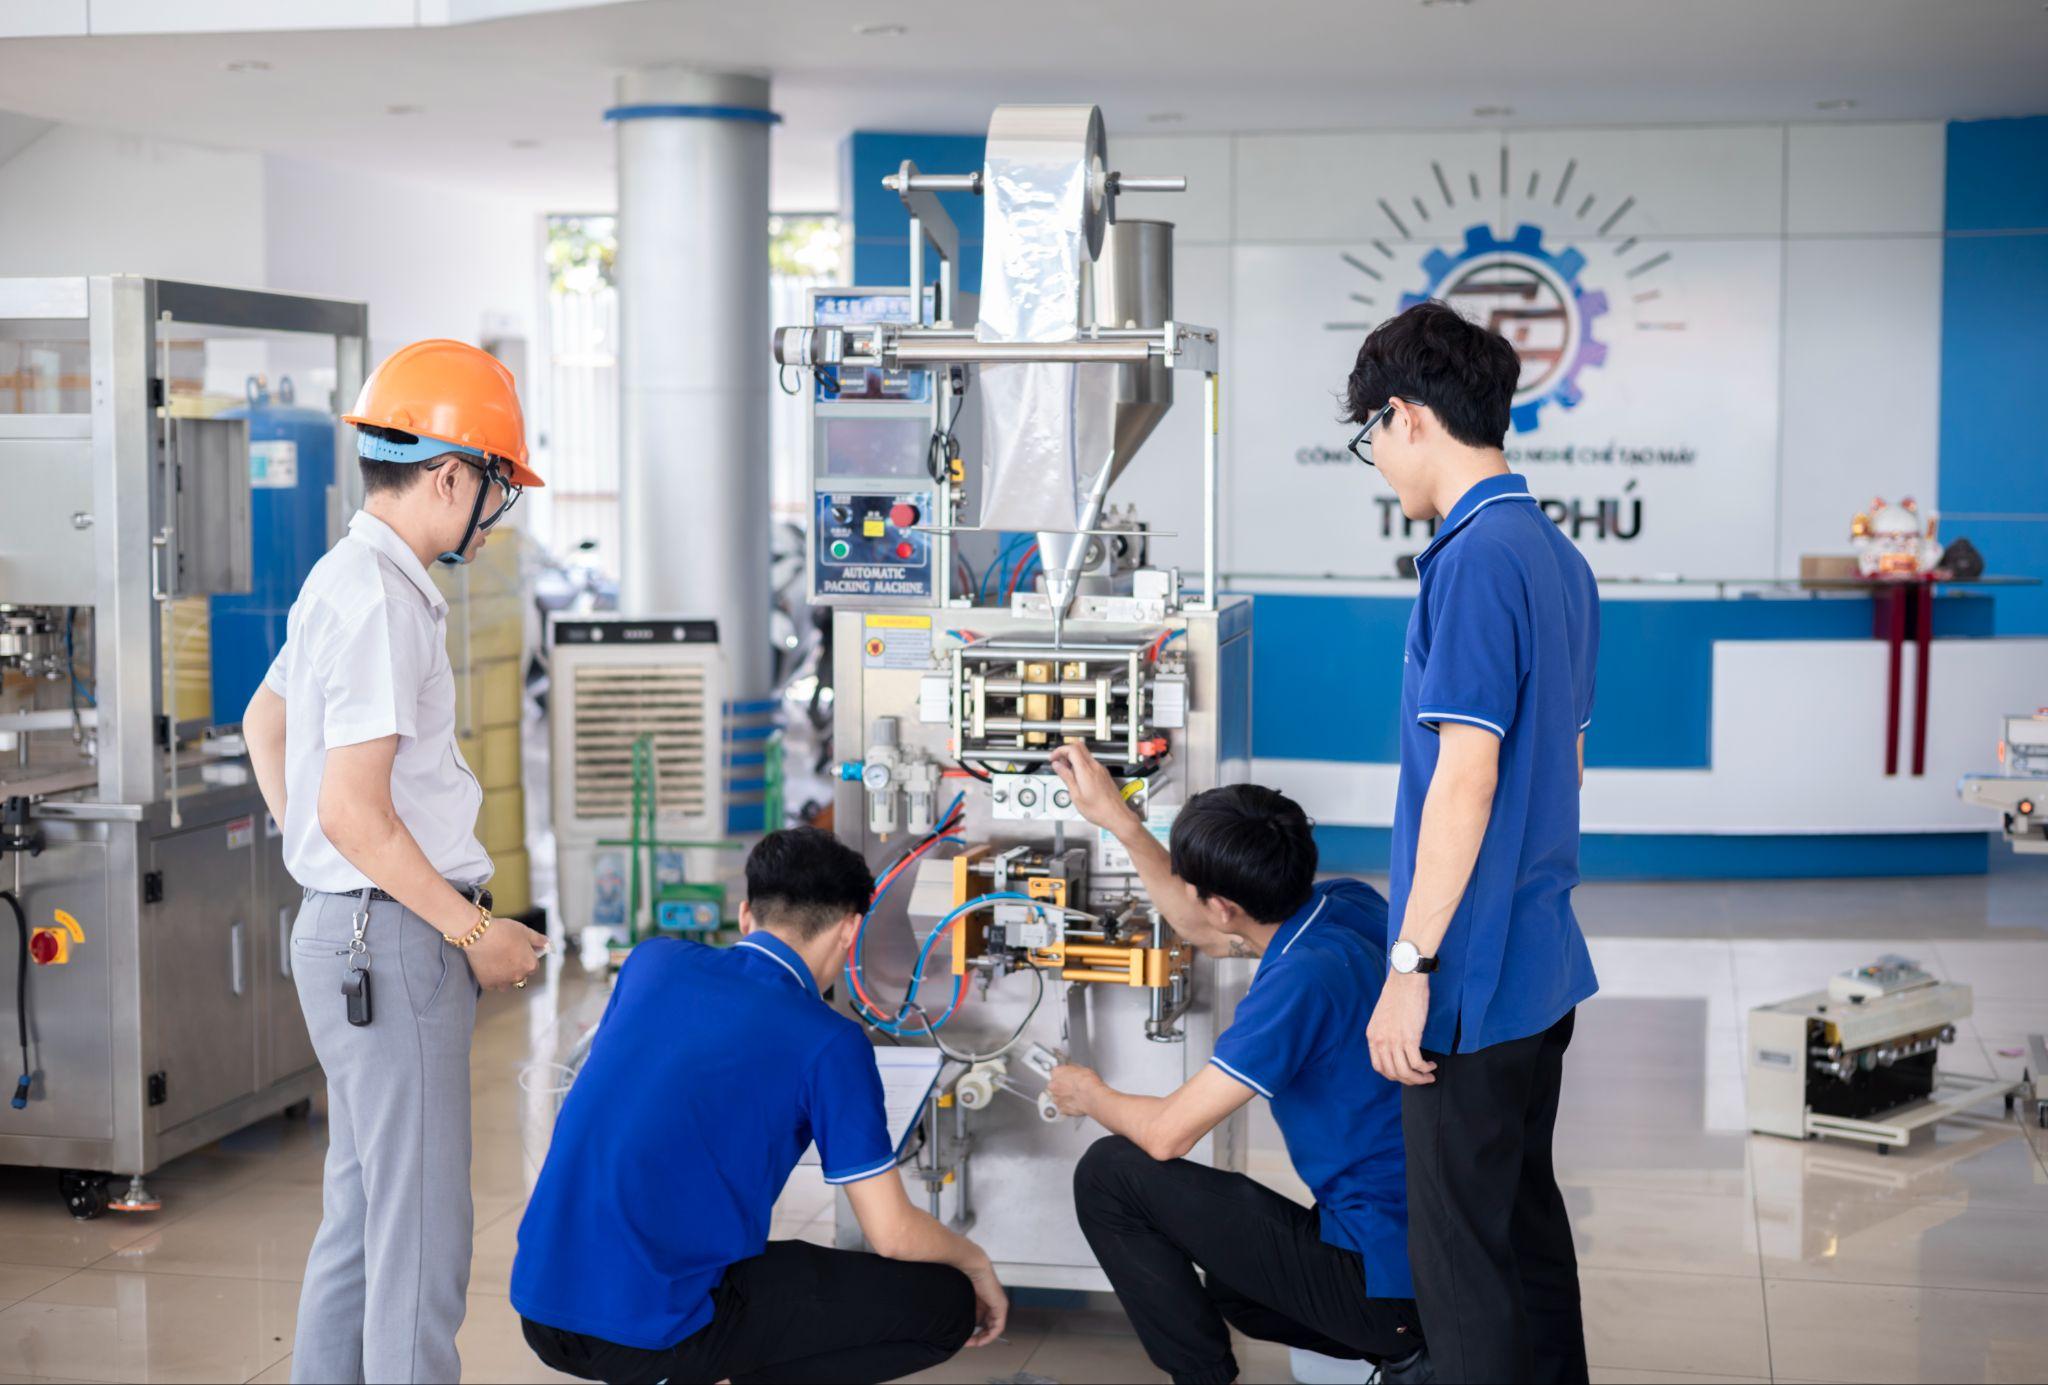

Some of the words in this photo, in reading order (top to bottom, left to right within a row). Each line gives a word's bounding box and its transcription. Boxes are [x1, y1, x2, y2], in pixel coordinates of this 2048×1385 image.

[1540, 478, 1642, 540] PHÚ
[842, 567, 906, 579] AUTOMATIC
[824, 580, 871, 593] PACKING
[874, 581, 924, 594] MACHINE
